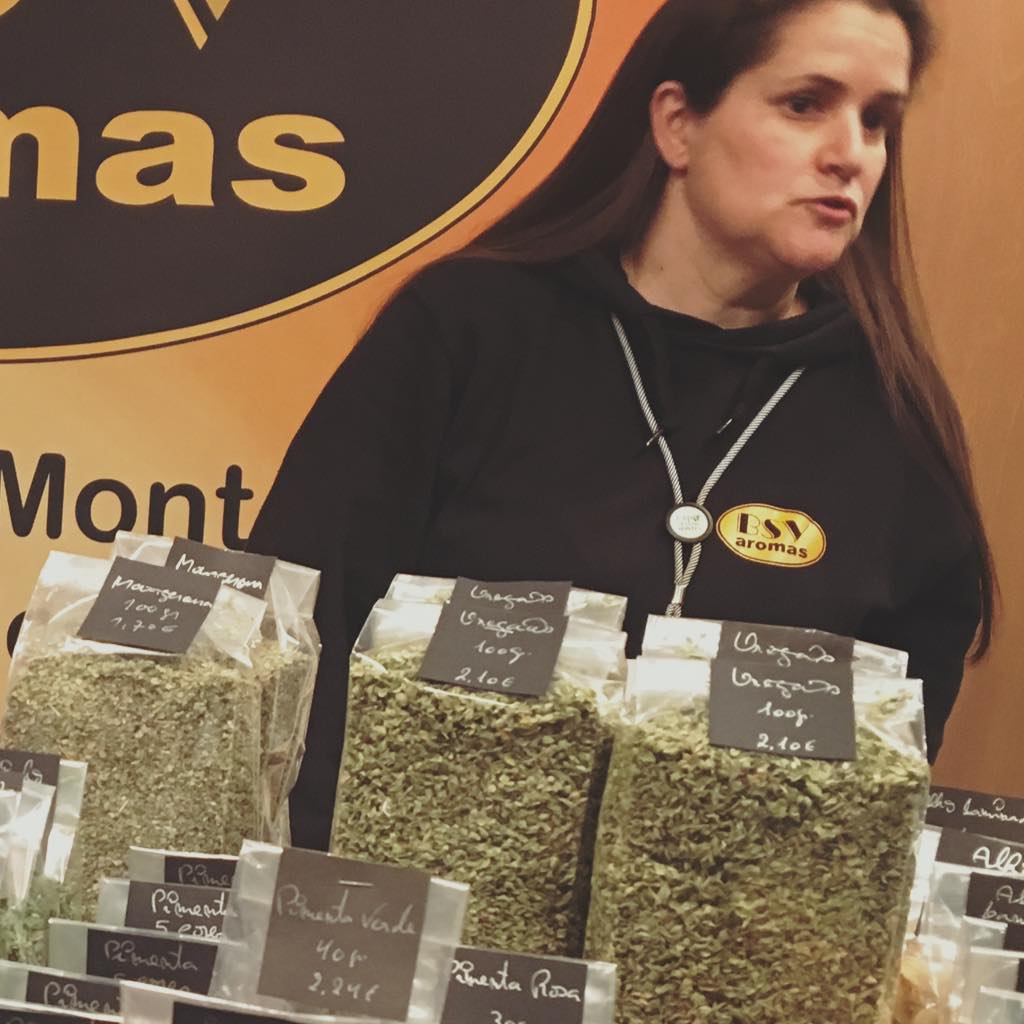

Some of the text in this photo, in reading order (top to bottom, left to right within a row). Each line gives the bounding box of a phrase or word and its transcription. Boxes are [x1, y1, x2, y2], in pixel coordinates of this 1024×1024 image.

[737, 512, 810, 543] BSV
[735, 536, 808, 559] aromas
[926, 791, 956, 813] lho
